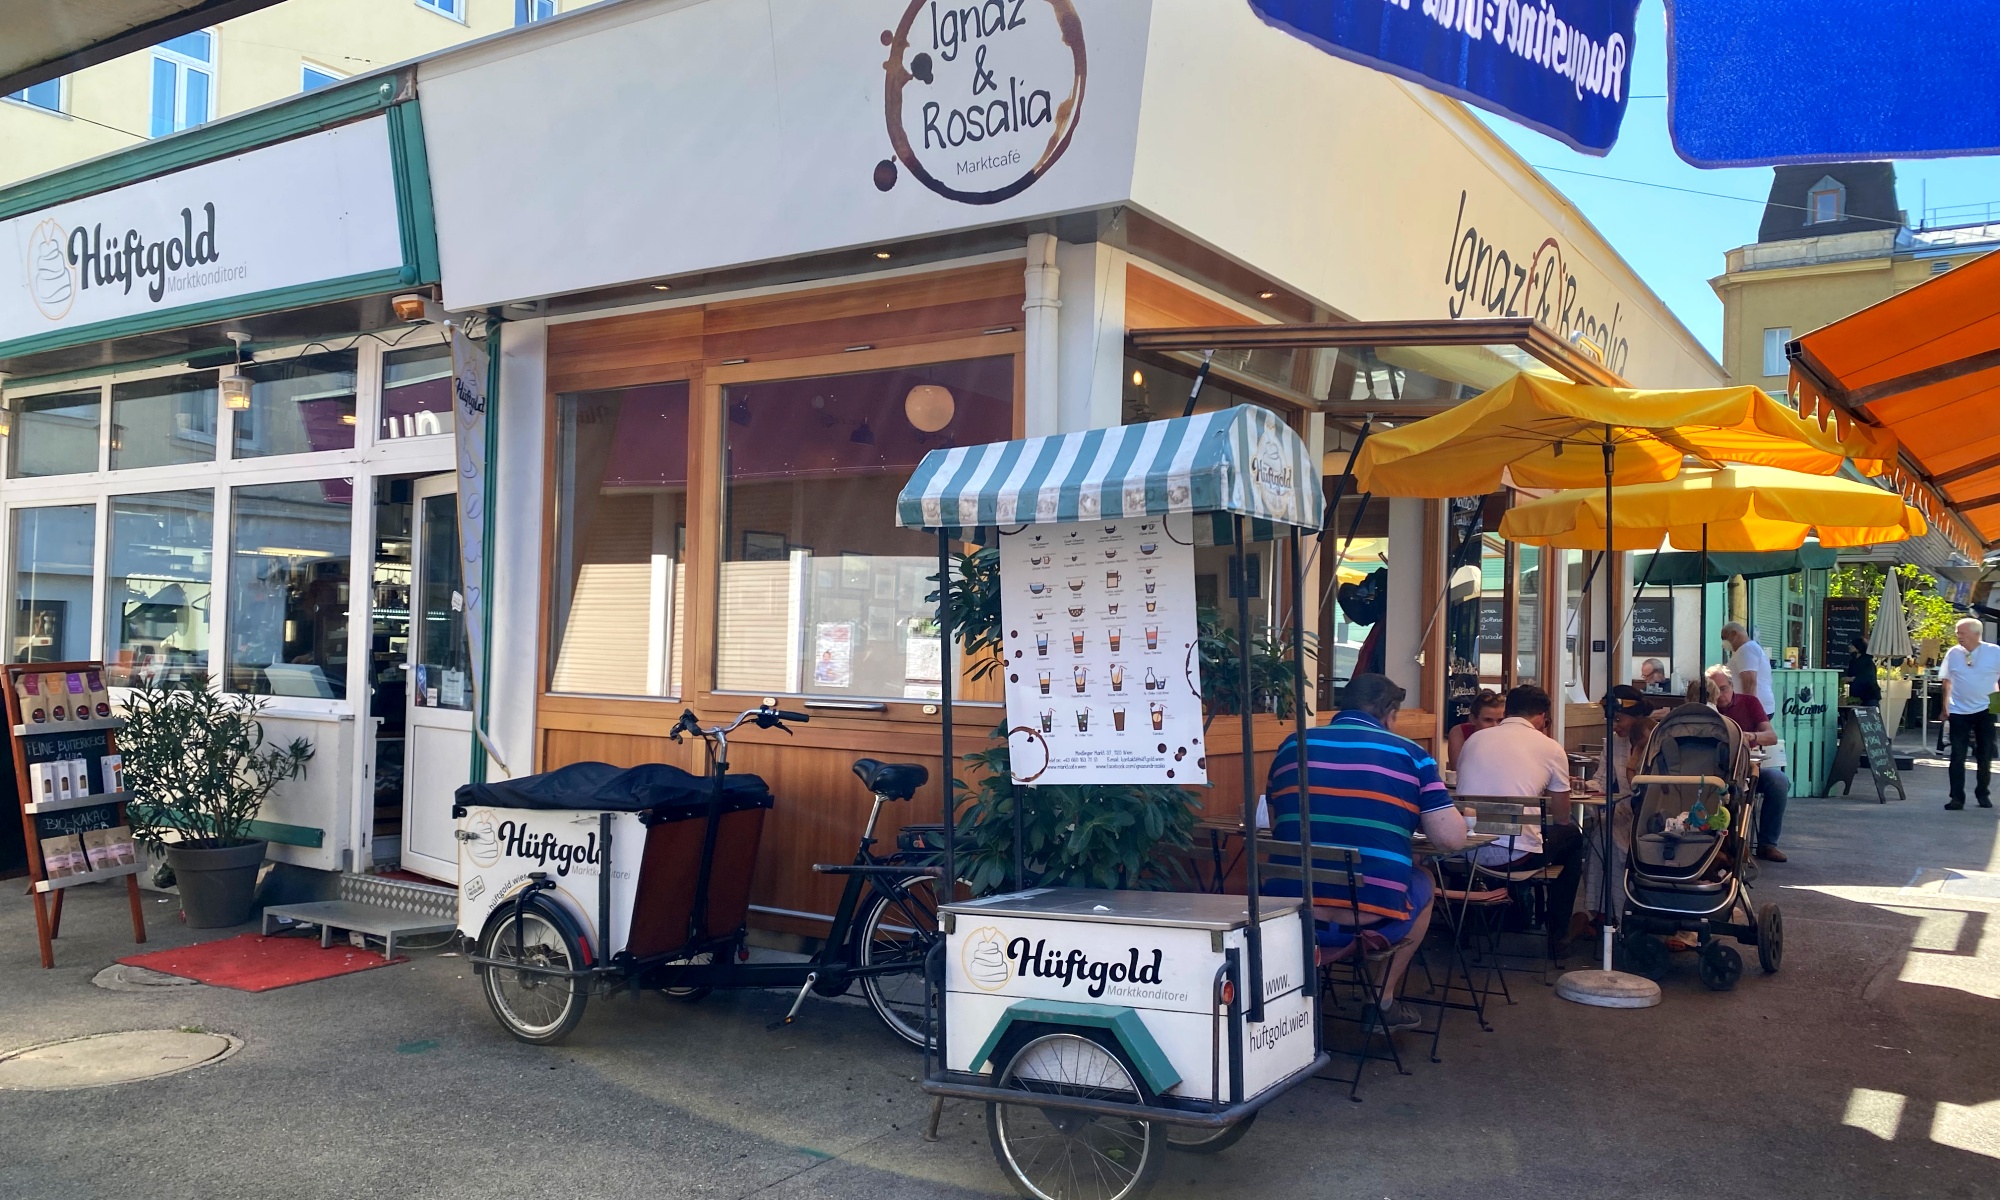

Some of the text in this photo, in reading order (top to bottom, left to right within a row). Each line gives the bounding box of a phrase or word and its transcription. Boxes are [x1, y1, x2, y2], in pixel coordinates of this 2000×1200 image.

[931, 0, 1026, 61] Ignaz
[972, 44, 998, 96] &
[922, 76, 1053, 150] Rosalia
[956, 149, 1021, 176] Marktcafé
[67, 201, 220, 303] Hüftgold
[1445, 189, 1527, 319] Ignaz
[1534, 255, 1555, 326] &
[167, 261, 248, 293] Marktkonditorei
[25, 740, 56, 757] FEINE
[571, 864, 631, 880] Marktkitorei
[1007, 936, 1163, 998] Hüftgold
[1265, 974, 1291, 996] www.
[1107, 984, 1188, 1002] Marktkonditorei
[1249, 1011, 1309, 1053] hüftgold.wien
